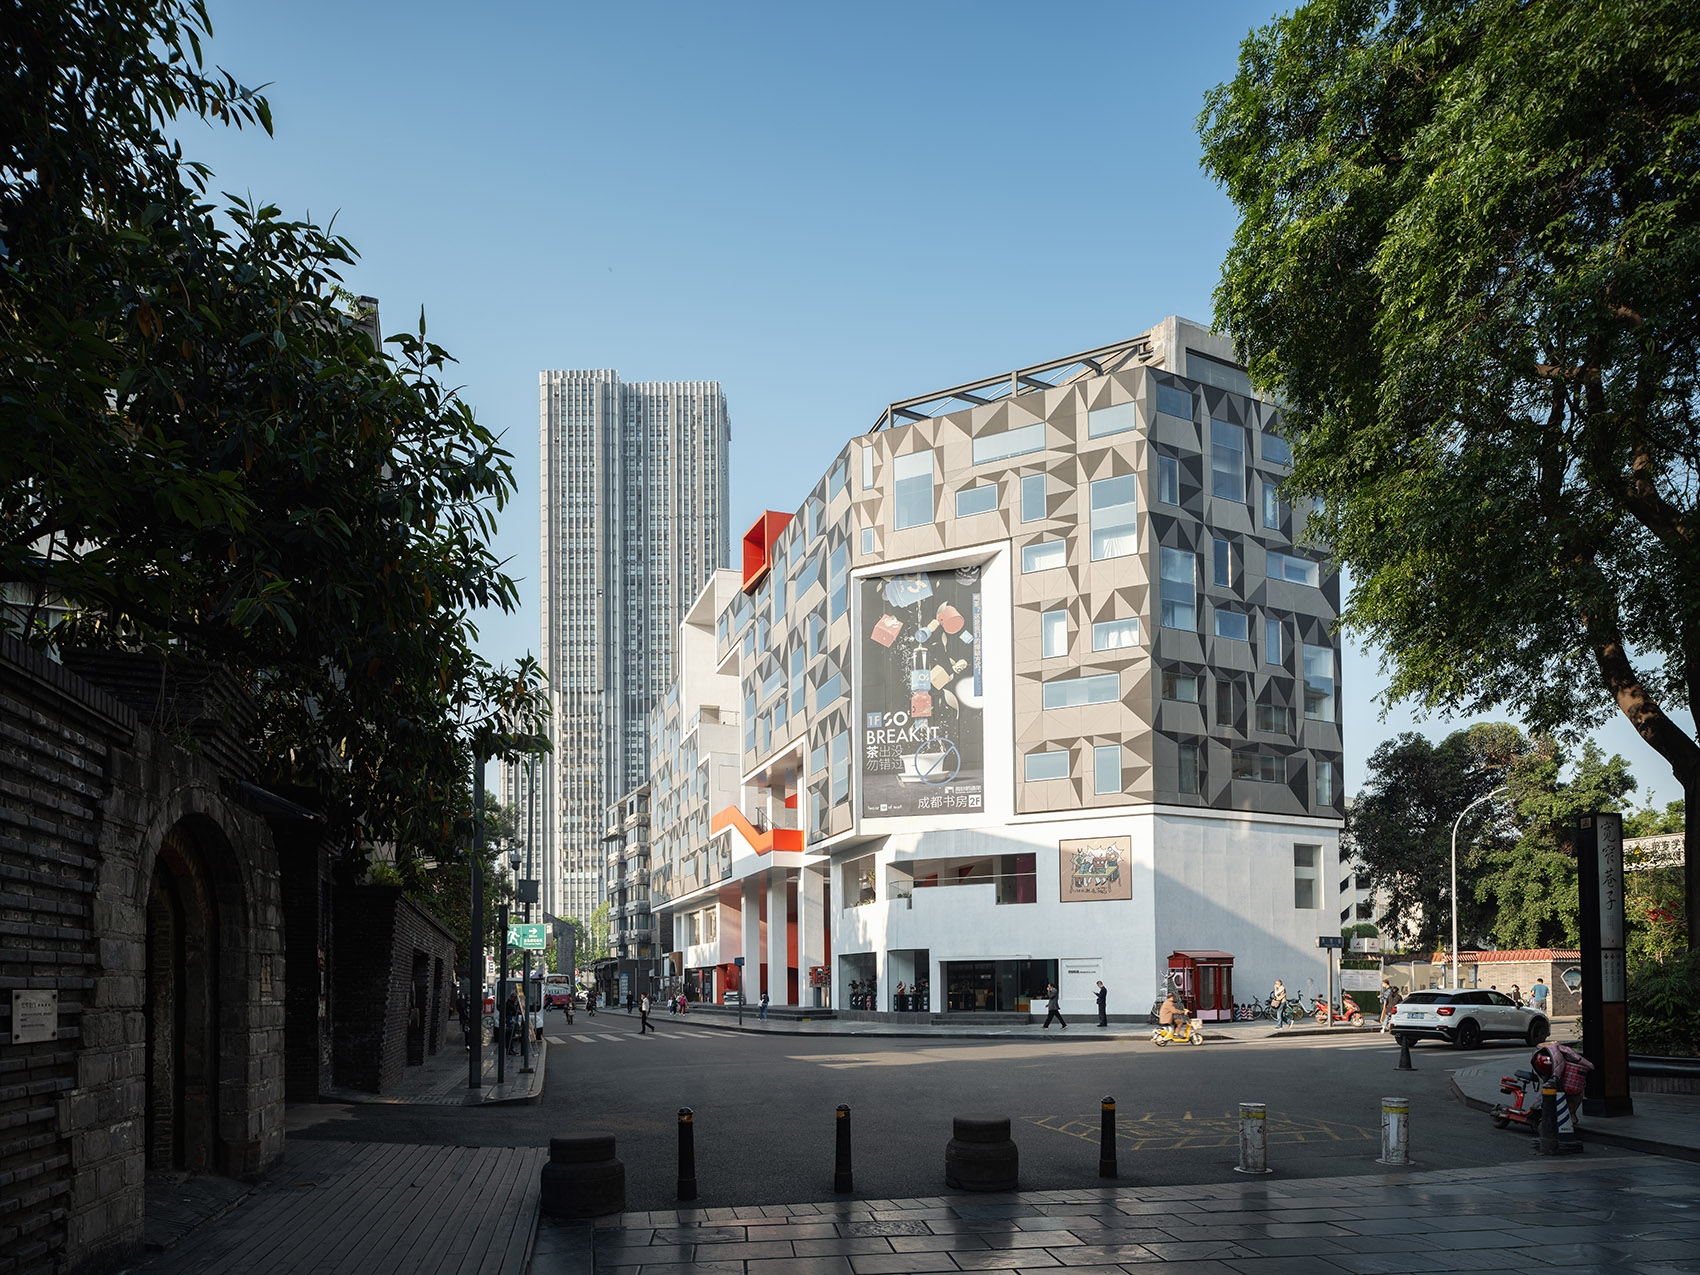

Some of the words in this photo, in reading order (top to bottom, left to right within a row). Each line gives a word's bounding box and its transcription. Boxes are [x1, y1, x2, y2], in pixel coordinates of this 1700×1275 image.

[867, 728, 920, 744] BREAK
[926, 726, 940, 742] IT
[866, 744, 904, 759] 茶出没
[866, 758, 904, 771] 勿错过
[917, 795, 968, 809] 成都书房
[969, 796, 981, 807] 2F
[1601, 821, 1616, 910] 宽窄巷子
